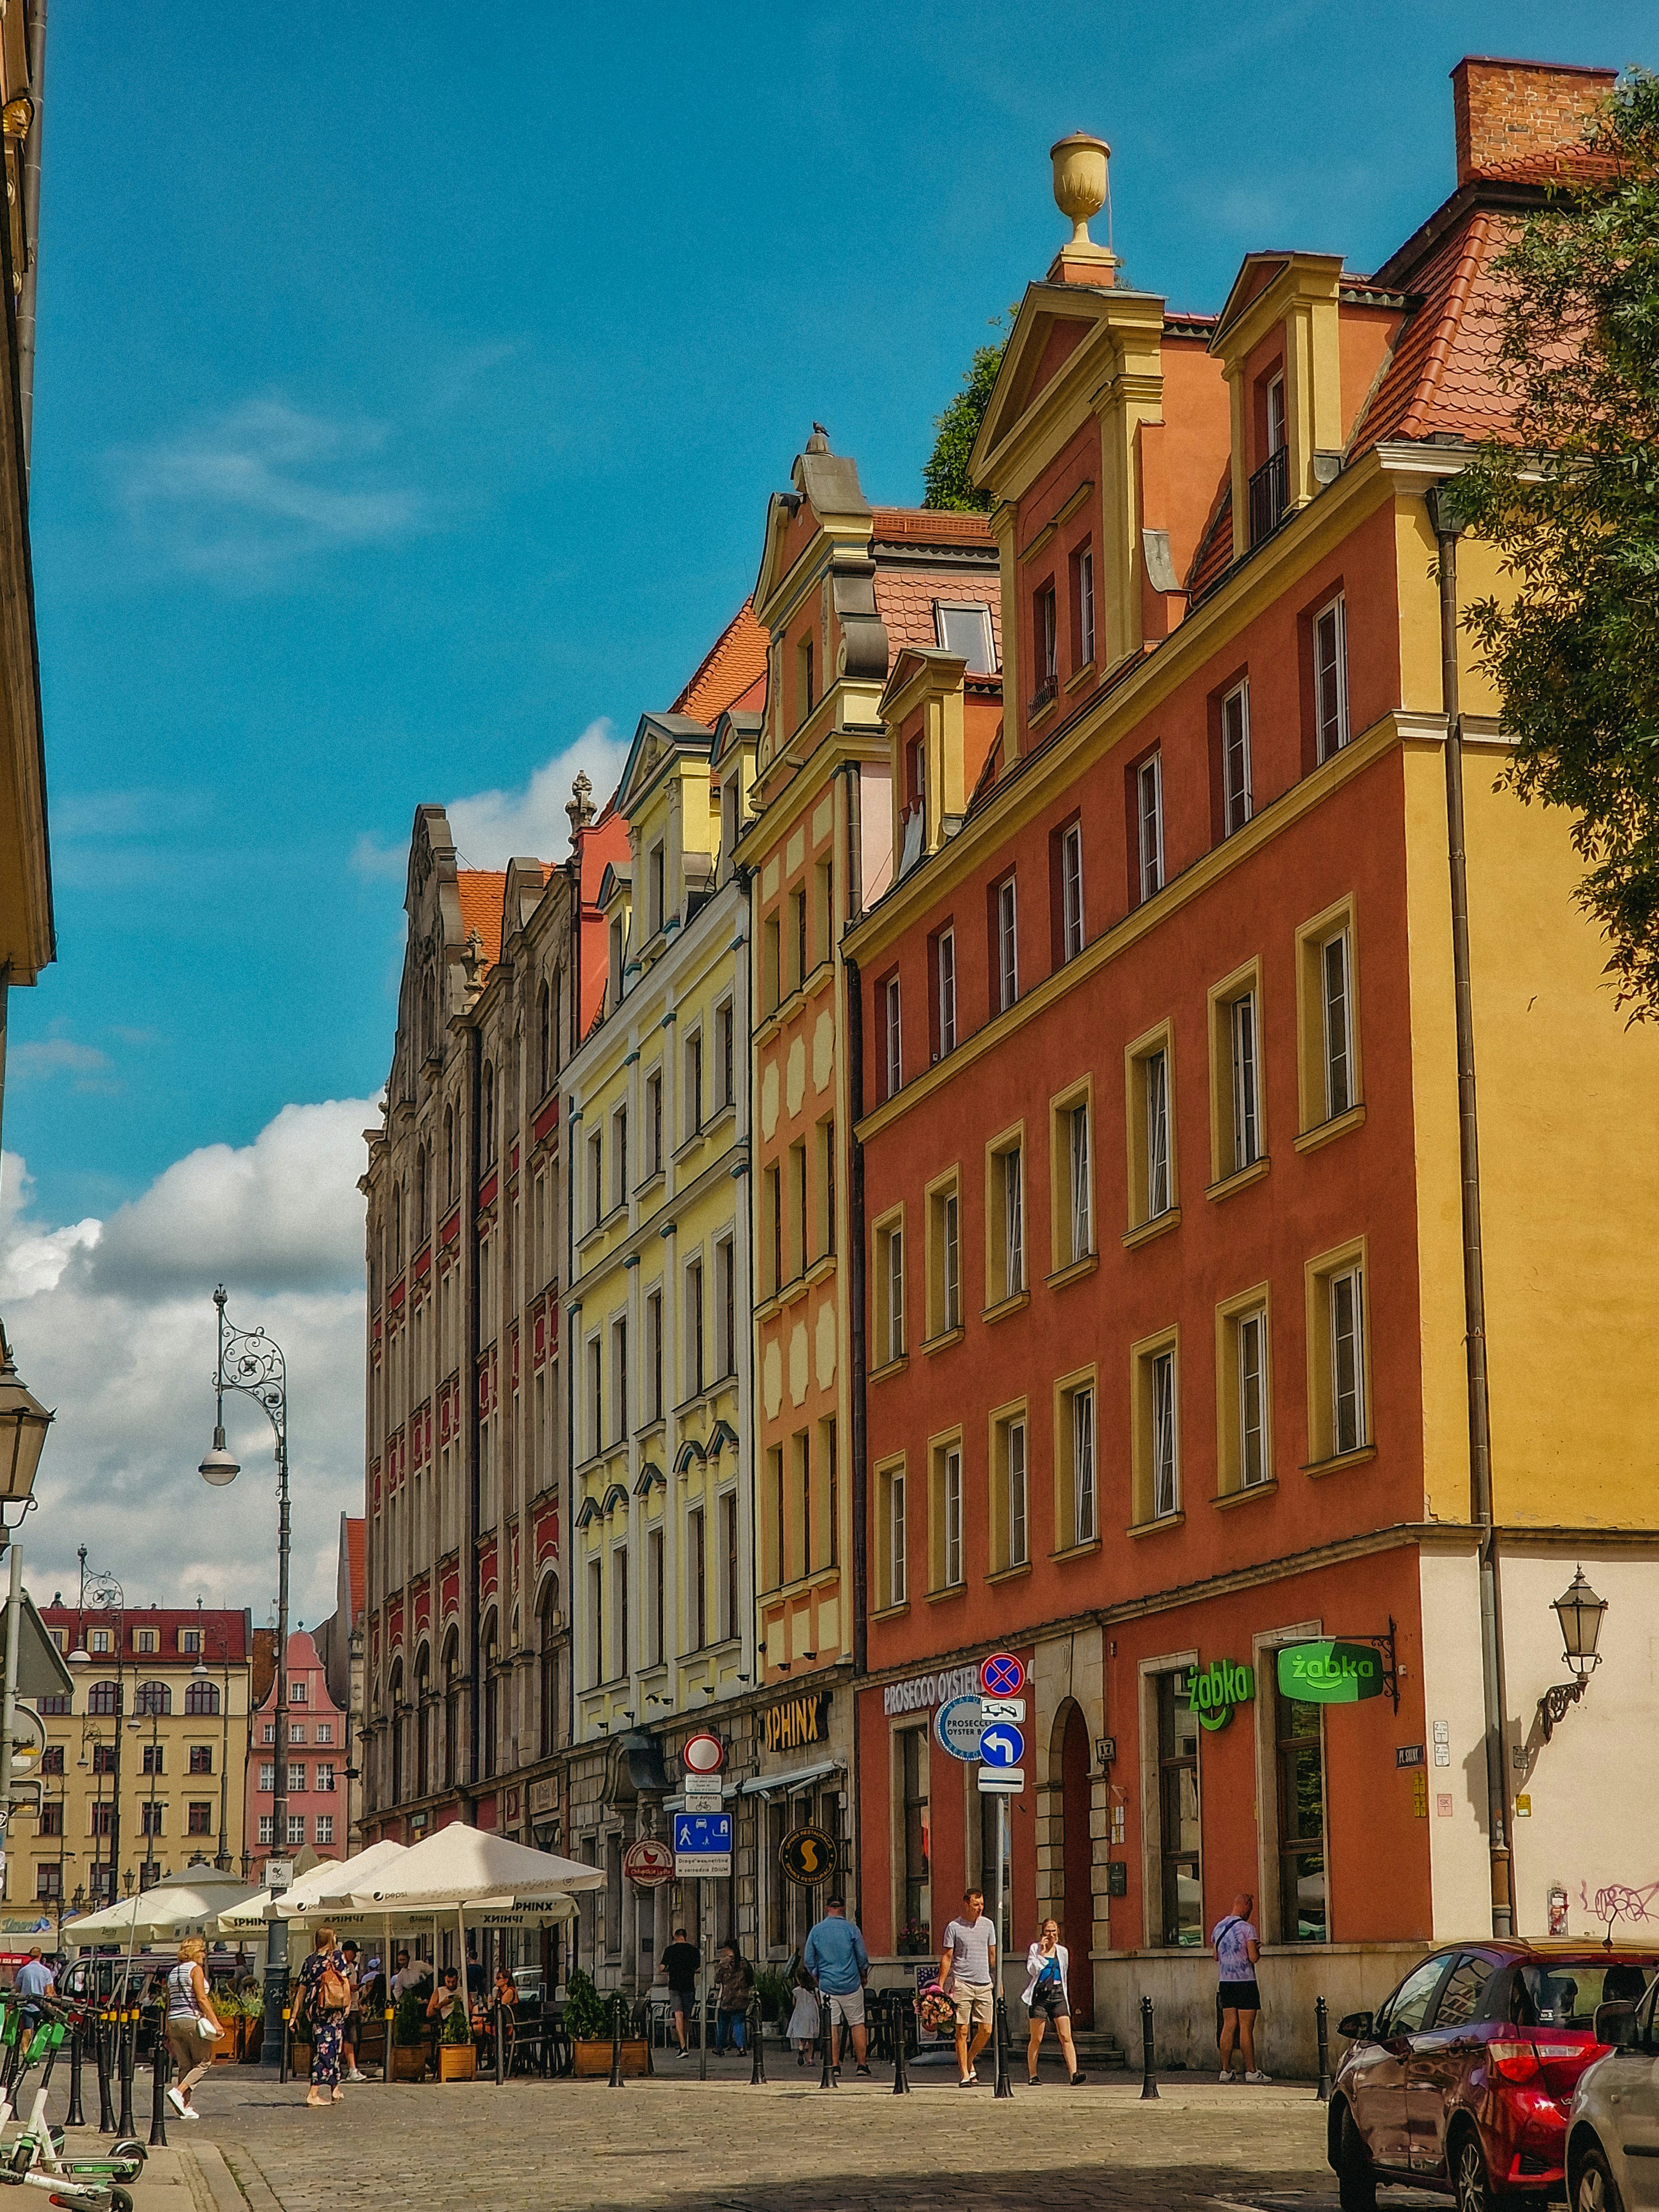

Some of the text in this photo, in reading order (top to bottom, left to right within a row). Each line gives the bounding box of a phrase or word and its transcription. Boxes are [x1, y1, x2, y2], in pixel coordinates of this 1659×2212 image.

[1293, 1655, 1373, 1678] żabka
[884, 1675, 935, 1715] PROSECCO
[938, 1665, 978, 1702] OYSTER
[1188, 1659, 1253, 1711] żabka
[947, 1696, 981, 1709] SEAFO
[767, 1696, 818, 1751] SPHINX
[1101, 1744, 1111, 1754] 17
[385, 1891, 407, 1900] pepsi
[234, 1918, 269, 1927] SPHIN
